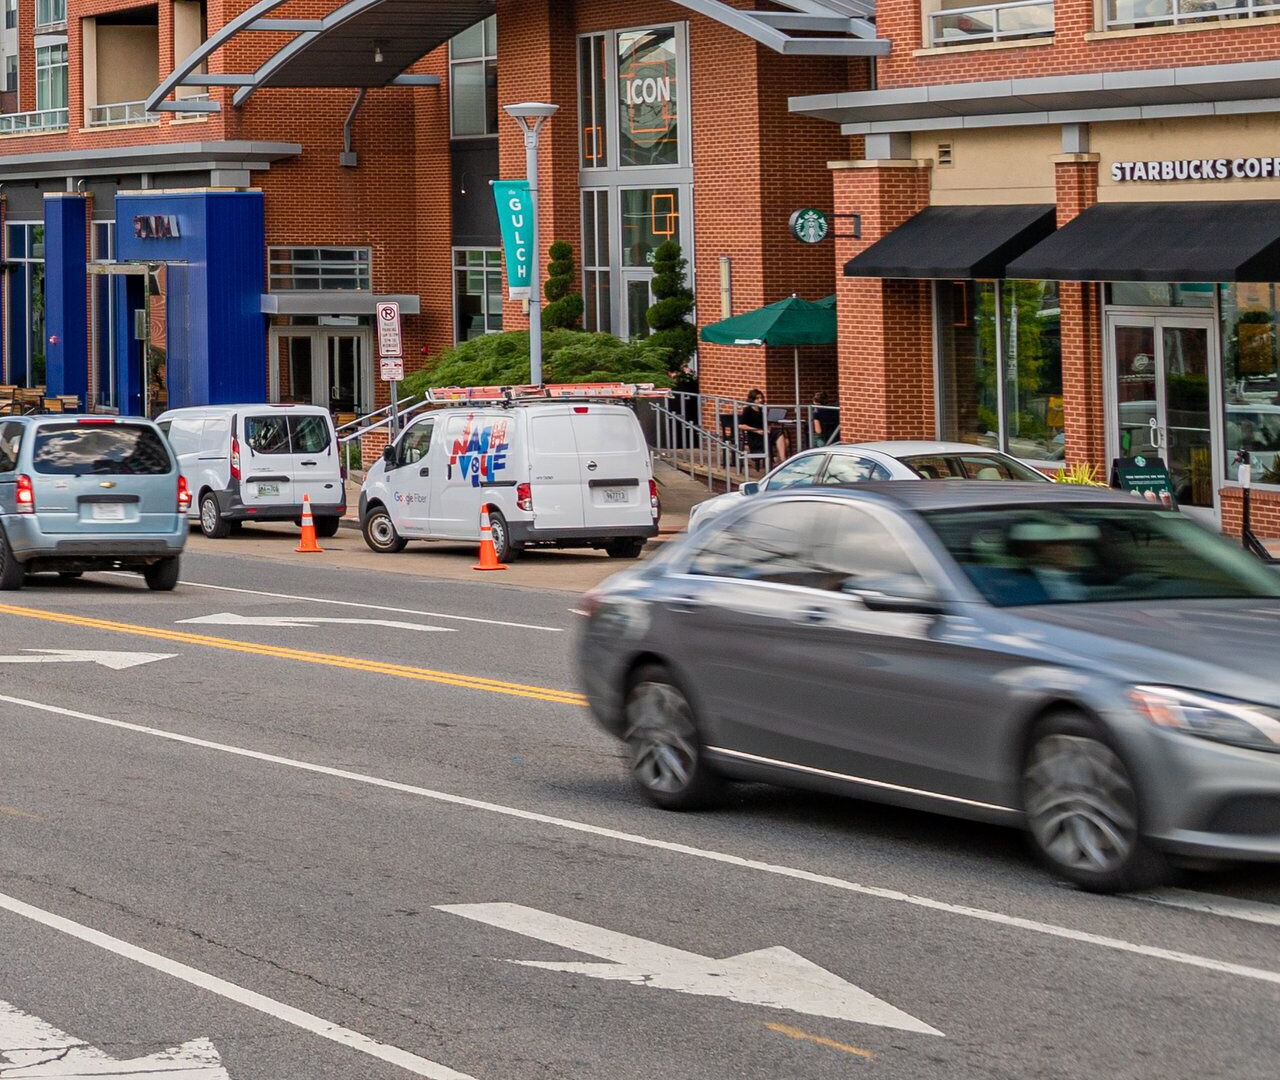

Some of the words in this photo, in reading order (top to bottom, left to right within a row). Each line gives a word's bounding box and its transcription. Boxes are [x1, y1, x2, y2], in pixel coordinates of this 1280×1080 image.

[626, 76, 671, 105] ICON
[1111, 158, 1228, 181] STARBUCKS
[508, 198, 527, 278] GULCH
